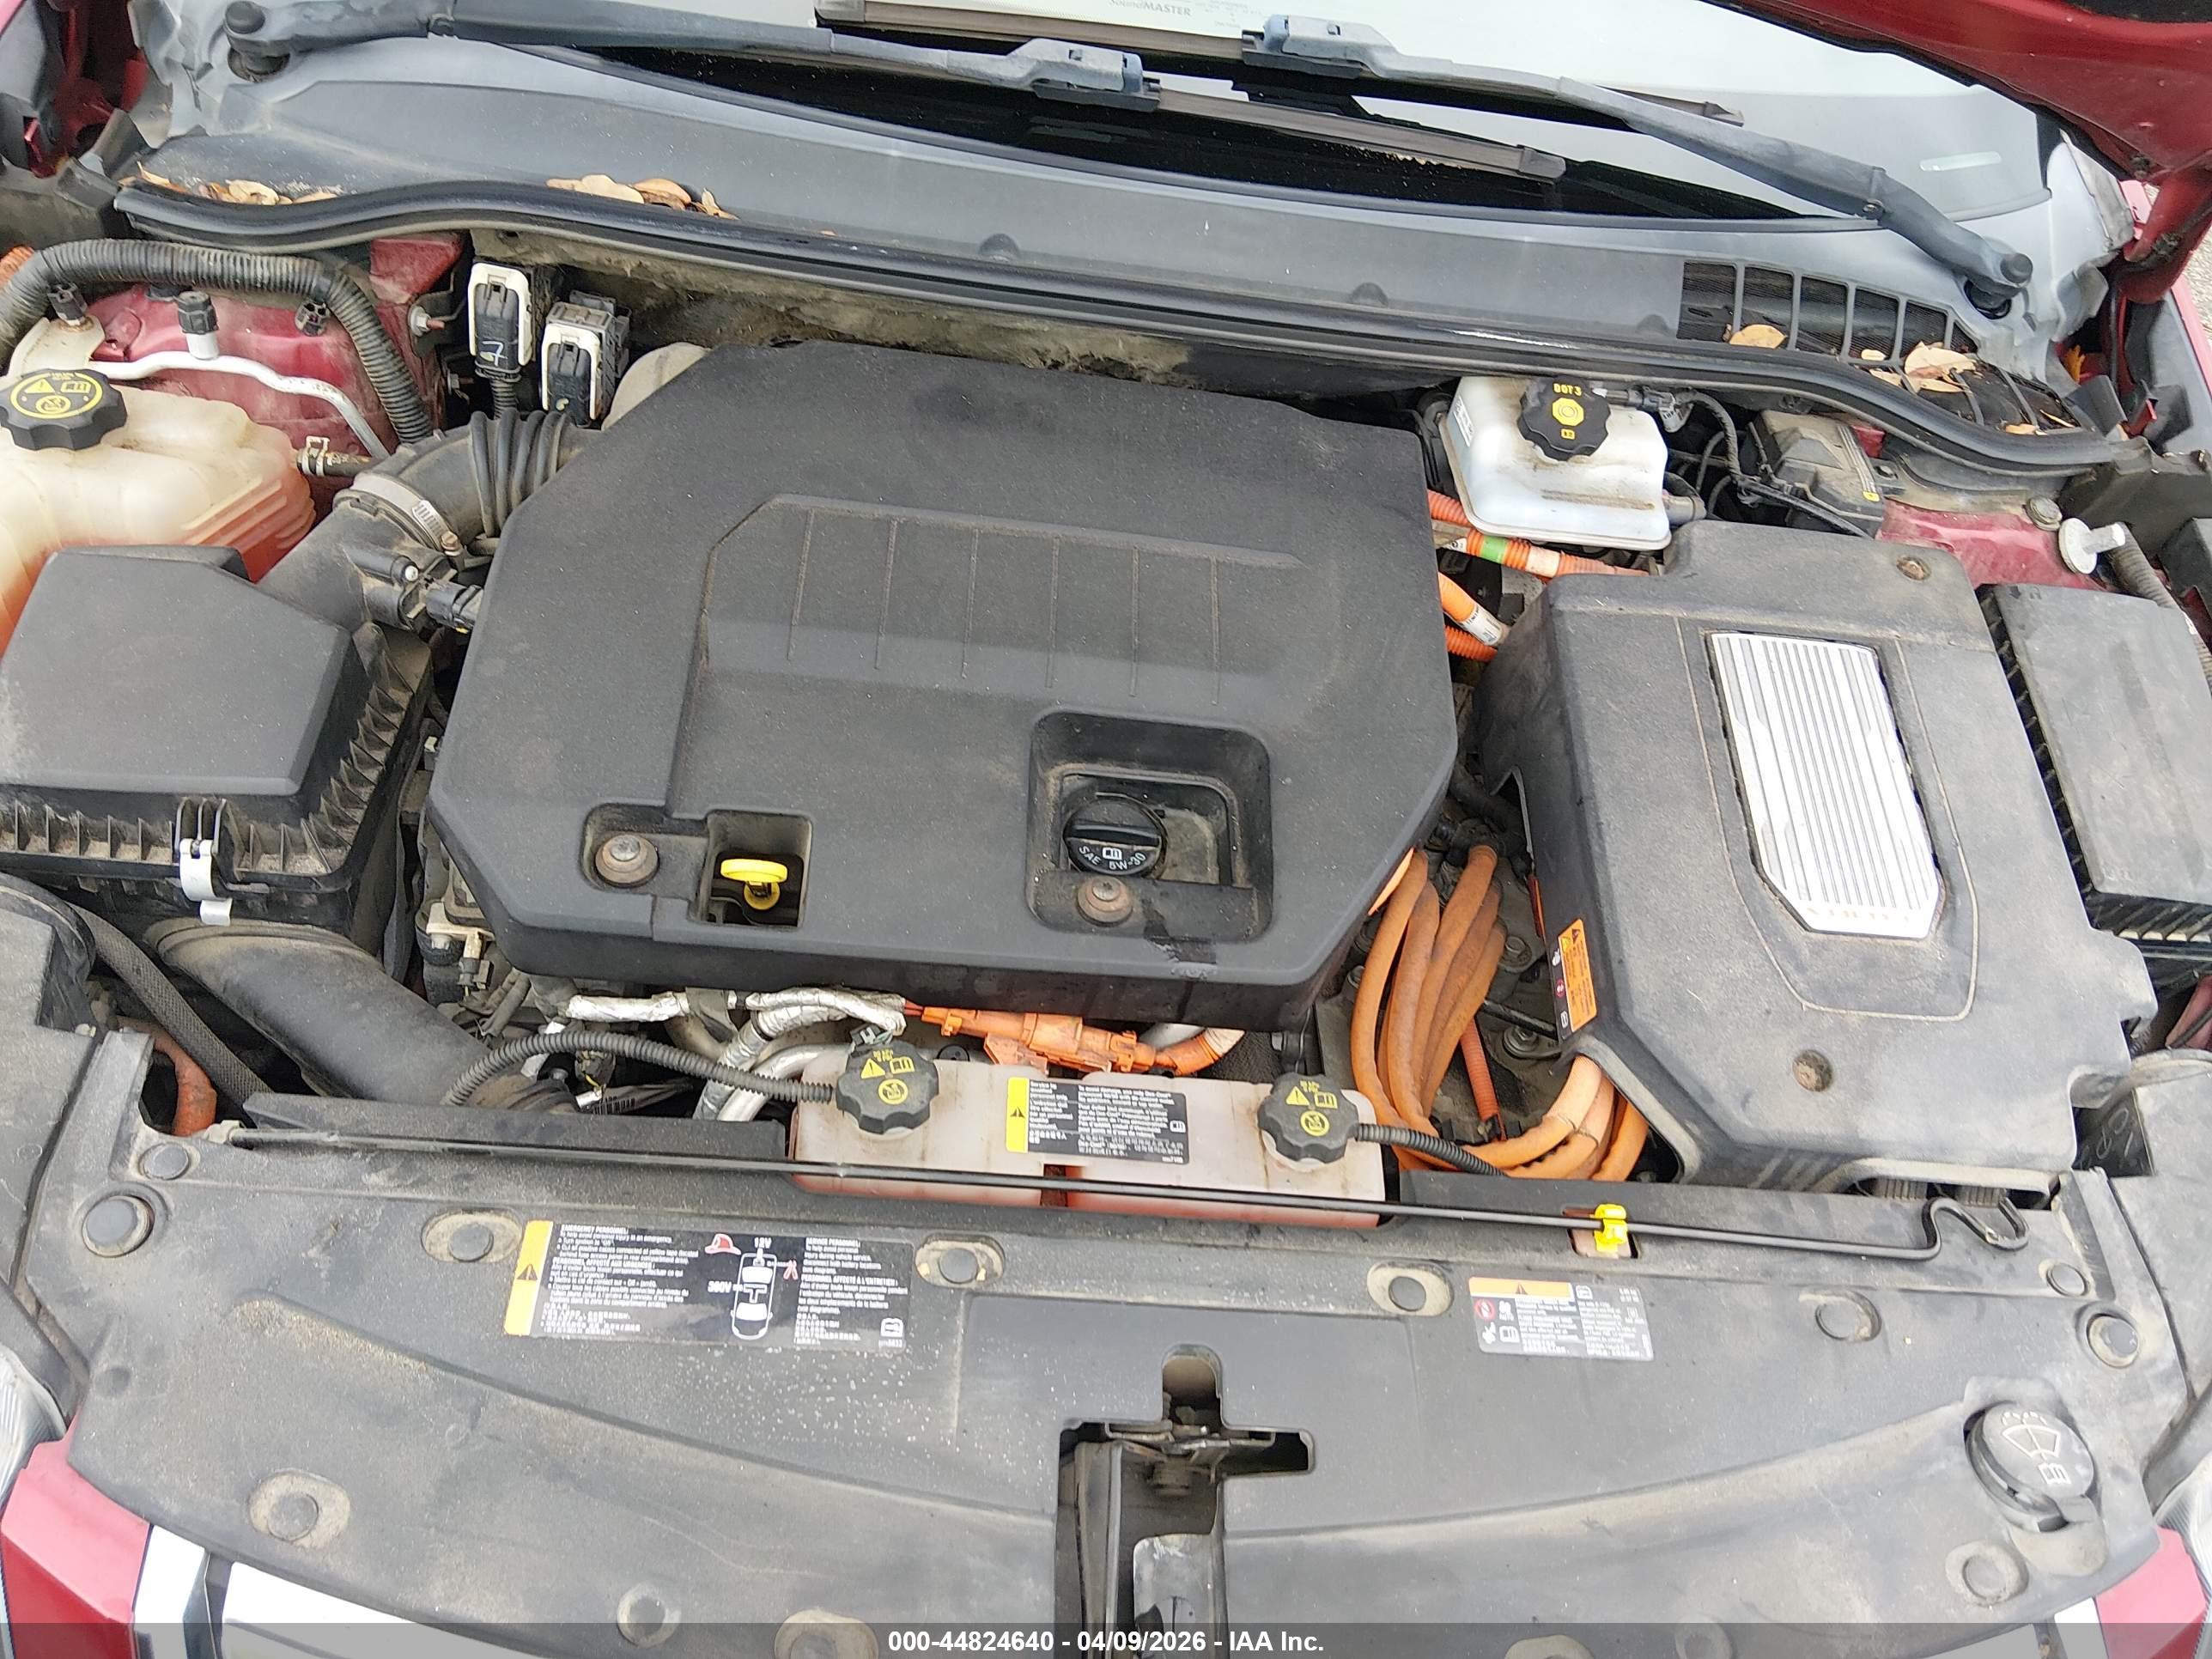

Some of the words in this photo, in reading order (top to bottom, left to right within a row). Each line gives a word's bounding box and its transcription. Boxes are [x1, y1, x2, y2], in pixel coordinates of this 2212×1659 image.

[1553, 383, 1573, 394] DOT
[1079, 845, 1102, 866] SAE
[1109, 852, 1146, 871] 5W-30
